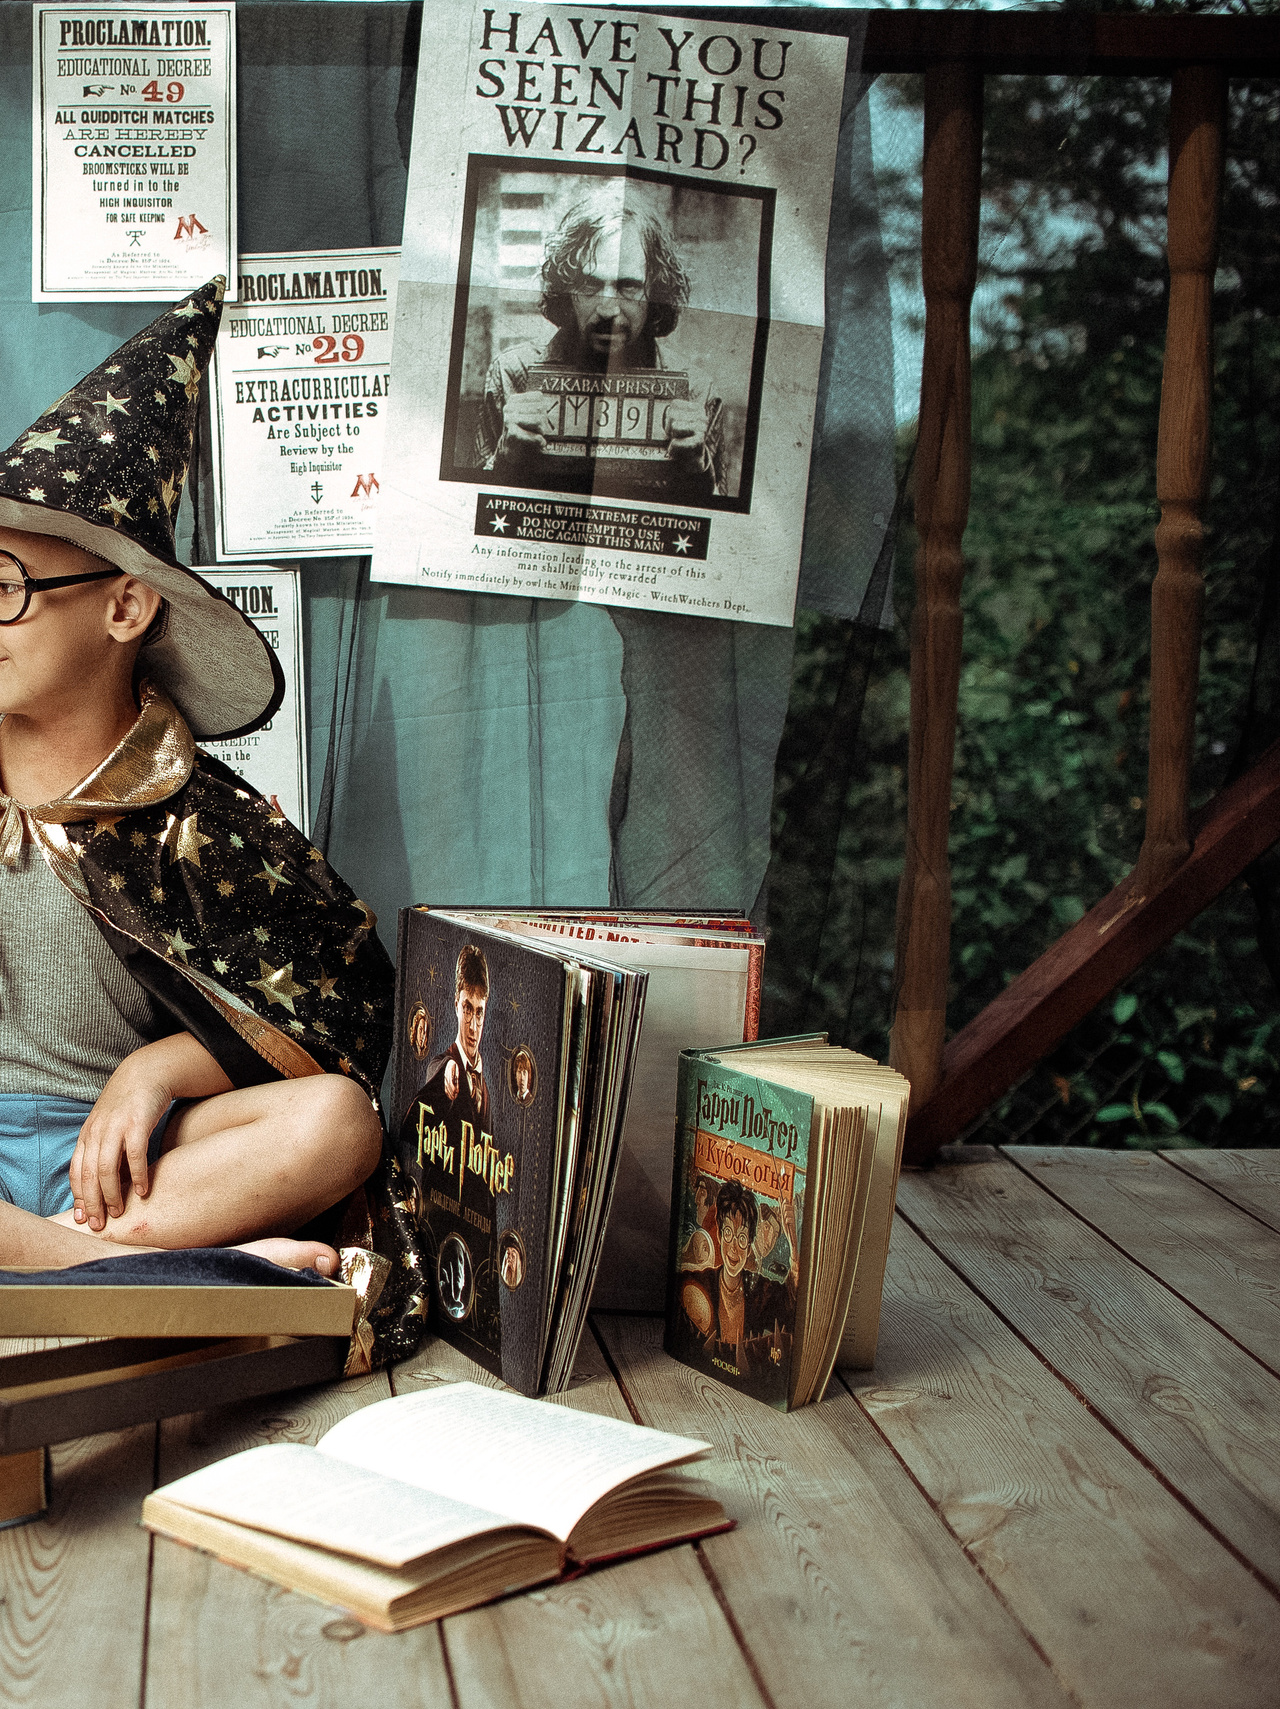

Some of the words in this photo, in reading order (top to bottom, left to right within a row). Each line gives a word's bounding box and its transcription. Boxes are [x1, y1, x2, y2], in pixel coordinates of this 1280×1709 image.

[60, 19, 211, 46] PROCLAMATION.
[479, 9, 639, 63] HAVE
[658, 28, 793, 81] YOU
[57, 59, 150, 77] EDUCATIONAL
[157, 58, 212, 77] DECREE
[141, 81, 185, 103] 49
[476, 59, 629, 110] SEEN
[647, 72, 785, 131] THIS
[55, 110, 76, 124] ALL
[81, 111, 148, 124] QUIDDITCH
[153, 110, 214, 124] MATCHES
[63, 128, 110, 140] ARE
[115, 128, 208, 140] HEREBY
[496, 104, 757, 175] WIZARD?
[74, 145, 197, 157] CANCELLED
[83, 163, 147, 175] BROOMSTICKS
[150, 163, 175, 175] WILL
[178, 163, 189, 175] BE
[93, 180, 129, 192] turned
[134, 180, 144, 191] in
[148, 181, 159, 191] to
[163, 180, 179, 191] the
[100, 198, 119, 208] HIGH
[123, 198, 173, 208] INQUISITOR
[106, 213, 118, 223] FOR
[121, 213, 136, 223] SAFE
[140, 213, 165, 223] KEEPING
[230, 316, 326, 338] EDUCATIONAL
[332, 312, 389, 333] DECREE
[313, 334, 364, 364] 29
[539, 378, 613, 393] AZKABAN
[616, 380, 676, 396] PRISON
[252, 402, 378, 423] ACTIVITIES
[268, 425, 290, 439] Are
[294, 424, 342, 441] Subject
[346, 422, 360, 436] to
[280, 445, 318, 457] Review
[322, 445, 334, 457] by
[338, 444, 354, 454] the
[290, 462, 307, 475] High
[309, 462, 342, 473] Inquisitor
[486, 499, 551, 515] APPROACH
[555, 505, 584, 518] WITH
[586, 511, 638, 524] EXTREME
[641, 515, 701, 532] CAUTION!
[517, 527, 554, 540] MAGIC
[556, 531, 602, 545] AGAINST
[605, 535, 631, 548] THIS
[634, 539, 664, 552] MAN!
[522, 517, 540, 527] DO
[544, 519, 567, 530] NOT
[568, 522, 617, 536] ATTEMPT
[619, 526, 635, 537] TO
[638, 530, 661, 541] USE
[471, 544, 493, 558] Any
[497, 546, 558, 561] information
[562, 552, 596, 568] leading
[601, 558, 611, 567] to
[616, 559, 632, 570] the
[636, 564, 667, 574] arrest
[670, 566, 683, 576] of
[686, 569, 706, 579] this
[518, 562, 538, 571] man
[541, 563, 565, 574] shall
[569, 564, 580, 576] be
[582, 566, 604, 581] duly
[609, 572, 657, 584] rewarded
[422, 567, 453, 581] Notify
[455, 570, 511, 585] immediately
[513, 576, 523, 586] by
[526, 578, 541, 587] owl
[544, 578, 557, 589] the
[560, 581, 595, 595] Ministry
[599, 587, 608, 595] of
[612, 586, 640, 599] Magic
[651, 591, 720, 609] WitchWatchers
[212, 737, 260, 747] CREDIT
[222, 751, 231, 761] in
[235, 750, 250, 760] the
[696, 1078, 740, 1132] Гарри
[740, 1094, 798, 1159] Поттер
[416, 1101, 455, 1175] Гарри
[459, 1120, 514, 1202] Поттер
[706, 1138, 751, 1173] Кубок
[754, 1165, 791, 1191] огня
